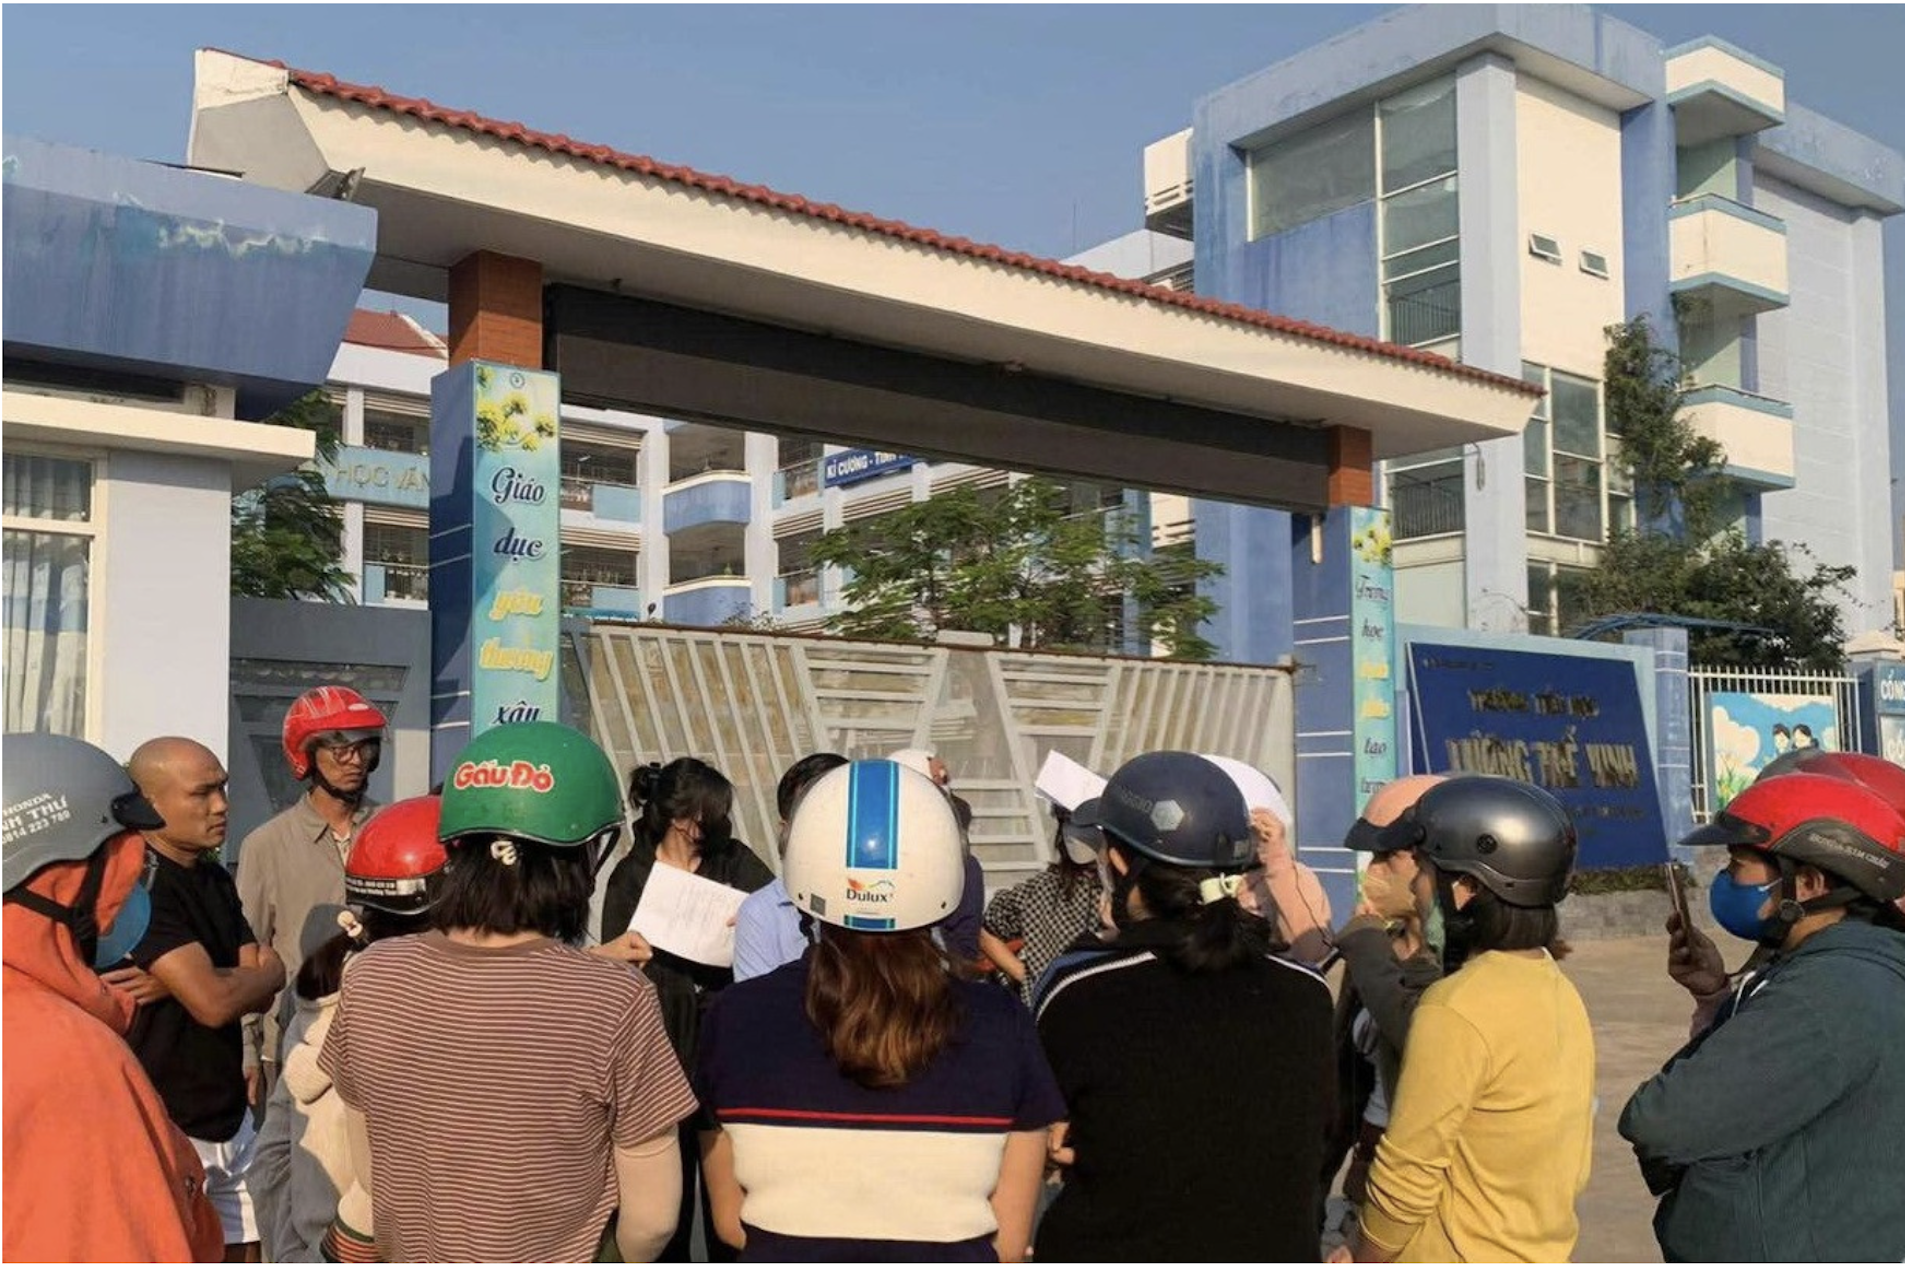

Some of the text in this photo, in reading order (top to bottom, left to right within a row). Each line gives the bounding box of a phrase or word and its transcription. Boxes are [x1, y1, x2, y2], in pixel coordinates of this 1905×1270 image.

[492, 467, 545, 505] Giáo
[493, 527, 544, 562] dục
[454, 759, 554, 793] Gấu Đỏ
[846, 888, 889, 903] Dulux
